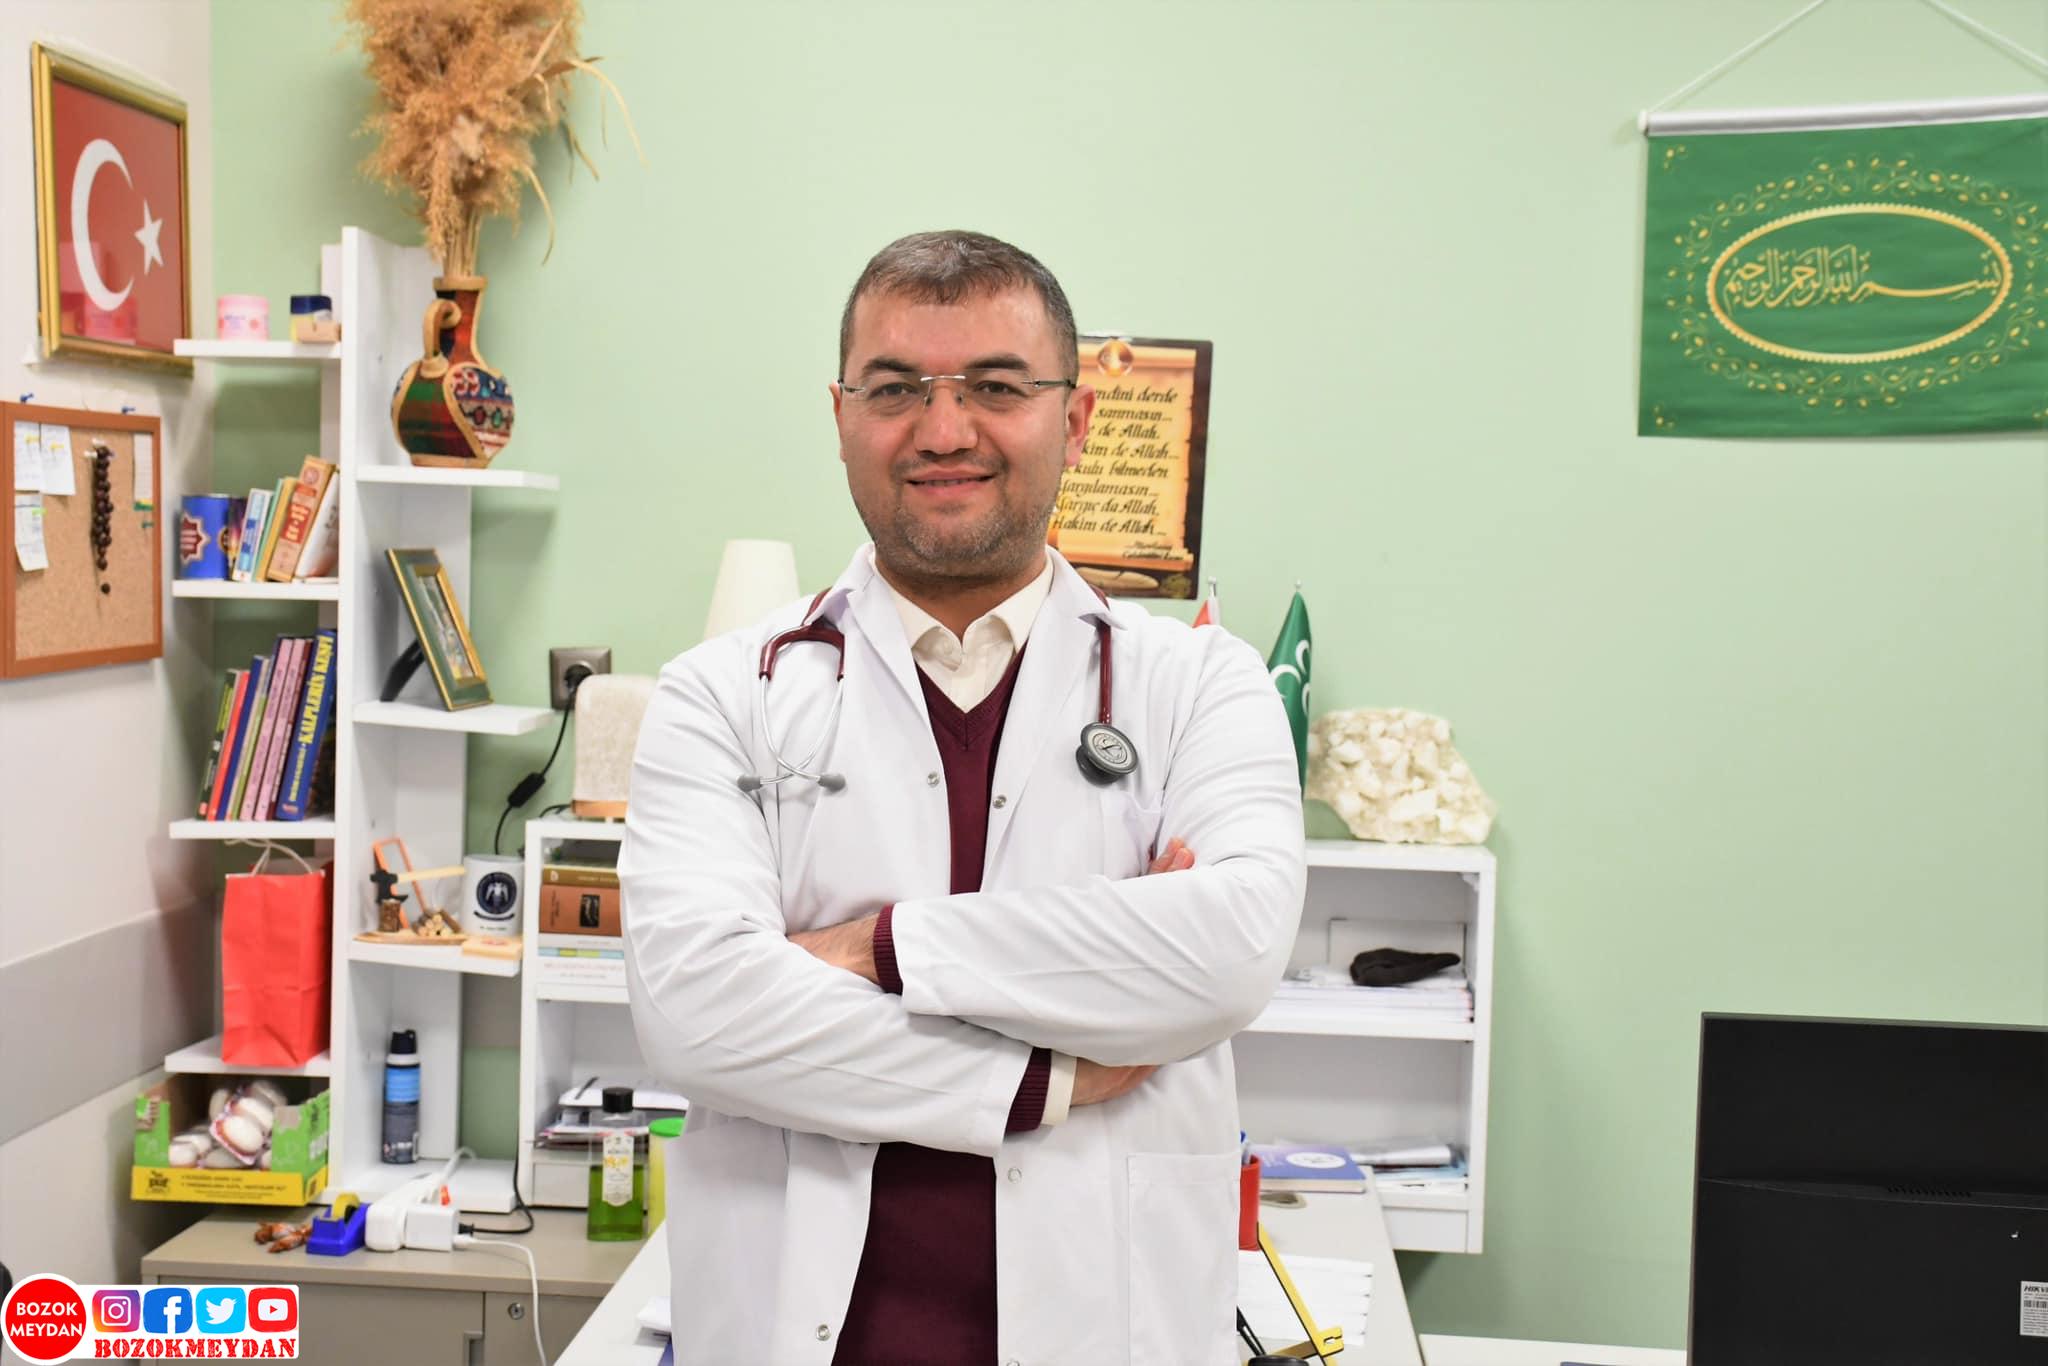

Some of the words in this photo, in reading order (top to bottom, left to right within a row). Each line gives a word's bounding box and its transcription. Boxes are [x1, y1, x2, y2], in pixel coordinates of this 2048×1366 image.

[1095, 384, 1134, 402] ndini
[1098, 422, 1115, 437] de
[1082, 442, 1109, 457] kim
[1111, 442, 1129, 457] de
[1101, 498, 1119, 513] da
[1100, 518, 1119, 533] de
